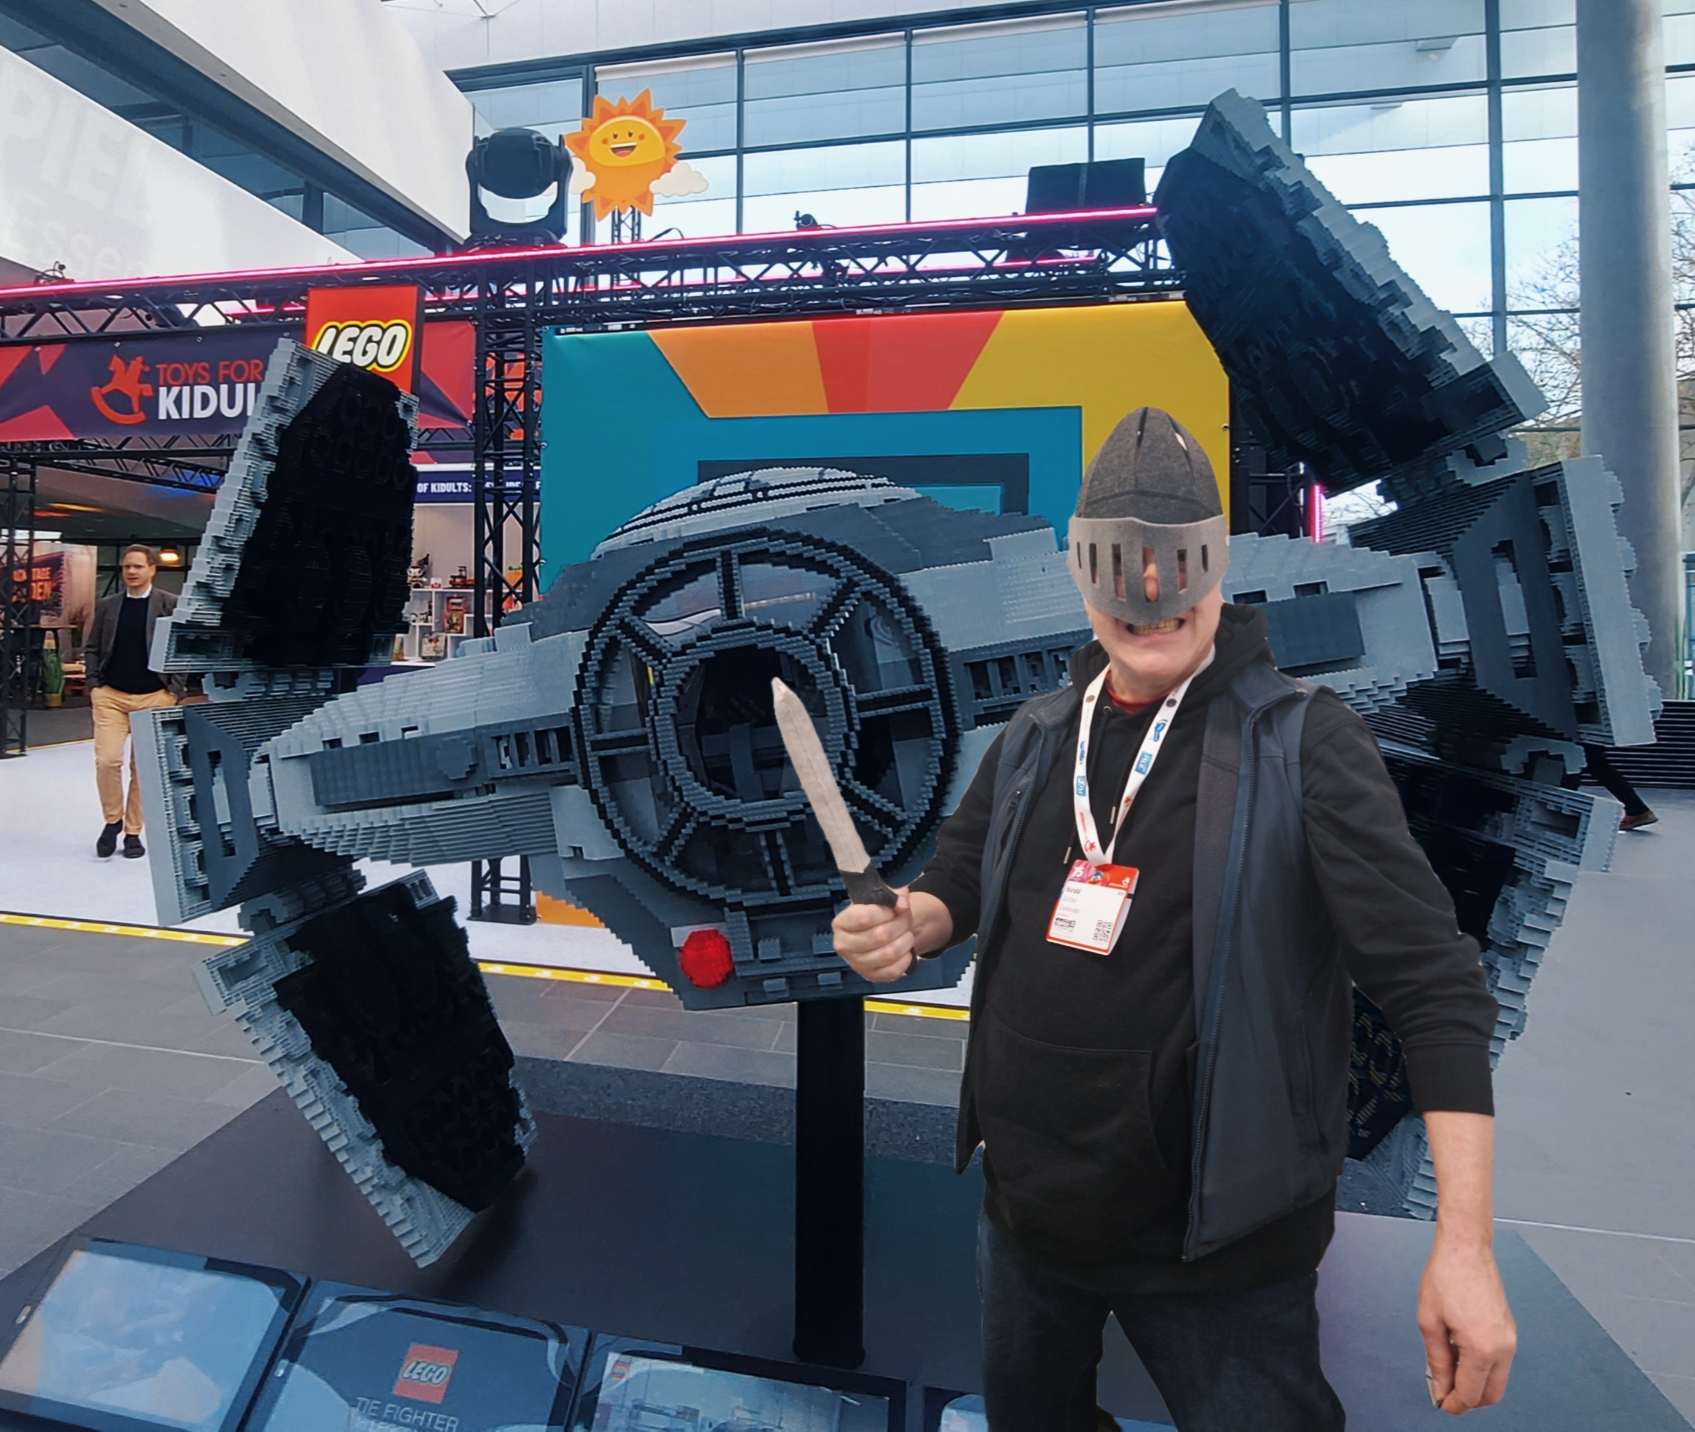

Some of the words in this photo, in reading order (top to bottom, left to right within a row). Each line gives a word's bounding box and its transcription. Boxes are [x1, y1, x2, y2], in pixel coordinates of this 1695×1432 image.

[318, 326, 407, 367] LEGO
[156, 361, 210, 386] TOYS
[218, 359, 263, 382] FOR
[417, 483, 428, 493] OF
[431, 482, 472, 493] KIDULTS:
[403, 1360, 449, 1384] LEGO
[356, 1397, 382, 1417] TIE
[383, 1403, 460, 1432] FIGHTER
